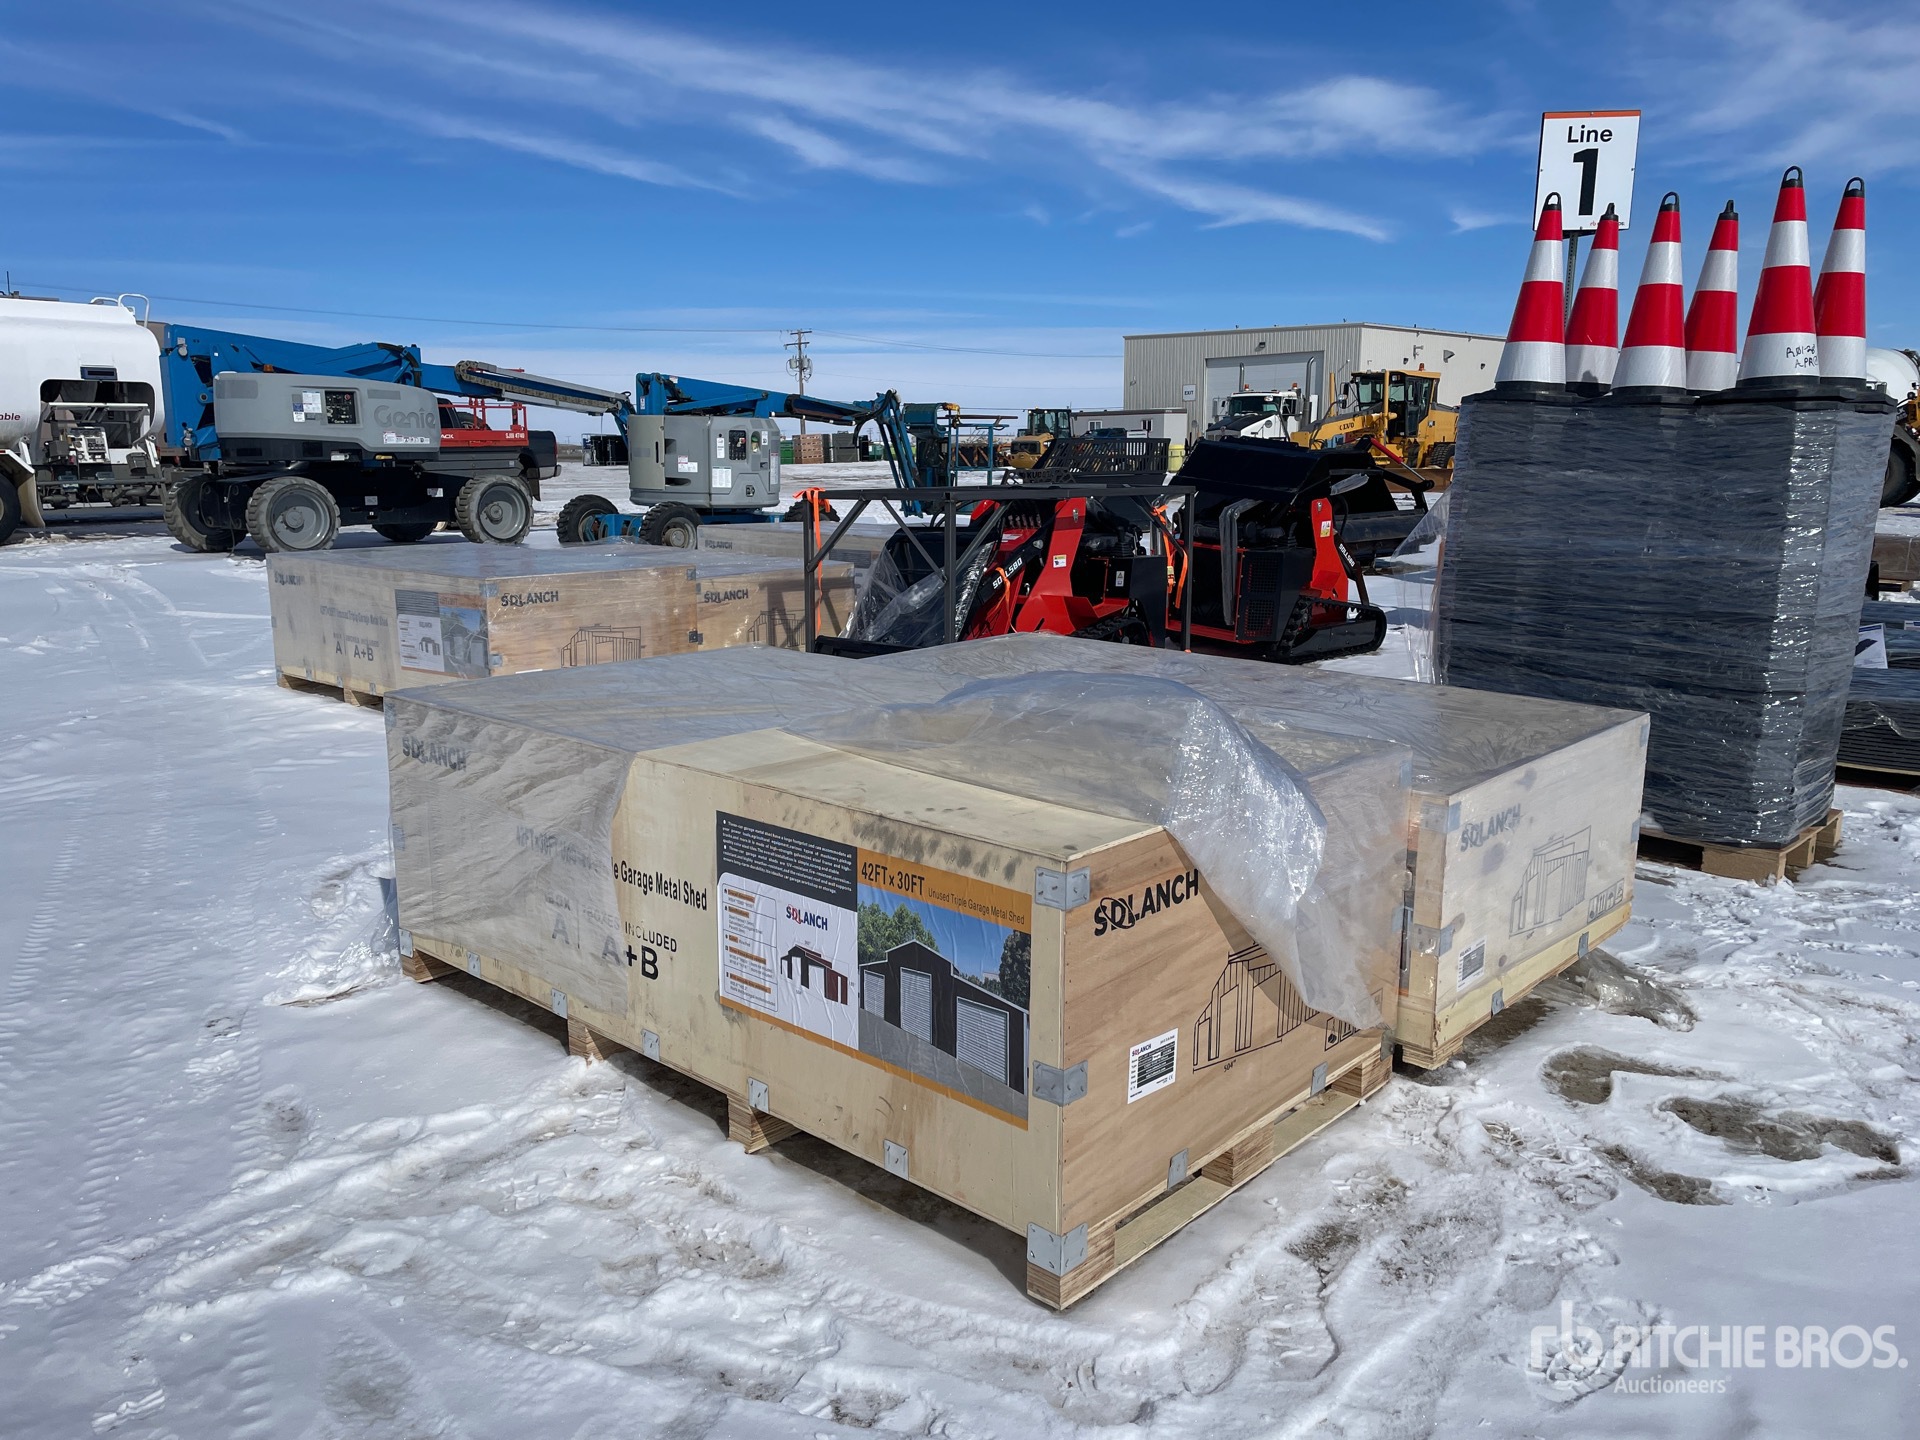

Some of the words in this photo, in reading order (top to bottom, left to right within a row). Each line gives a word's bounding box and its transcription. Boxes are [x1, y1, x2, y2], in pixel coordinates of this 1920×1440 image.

[1568, 125, 1613, 143] Line
[1573, 148, 1599, 216] 1
[374, 405, 436, 429] Genie
[992, 557, 1022, 590] SDL580
[336, 641, 342, 655] A
[354, 644, 374, 661] A+B
[621, 860, 653, 896] Garage
[655, 872, 681, 902] Metal
[683, 880, 707, 911] Shed
[862, 862, 888, 886] 42FT
[897, 871, 925, 896] 30FT
[928, 888, 950, 903] Unused
[951, 894, 967, 908] Triple
[968, 898, 990, 916] Garage
[990, 904, 1008, 919] Metal
[1009, 910, 1025, 925] Shed
[625, 921, 677, 953] INCLUDED
